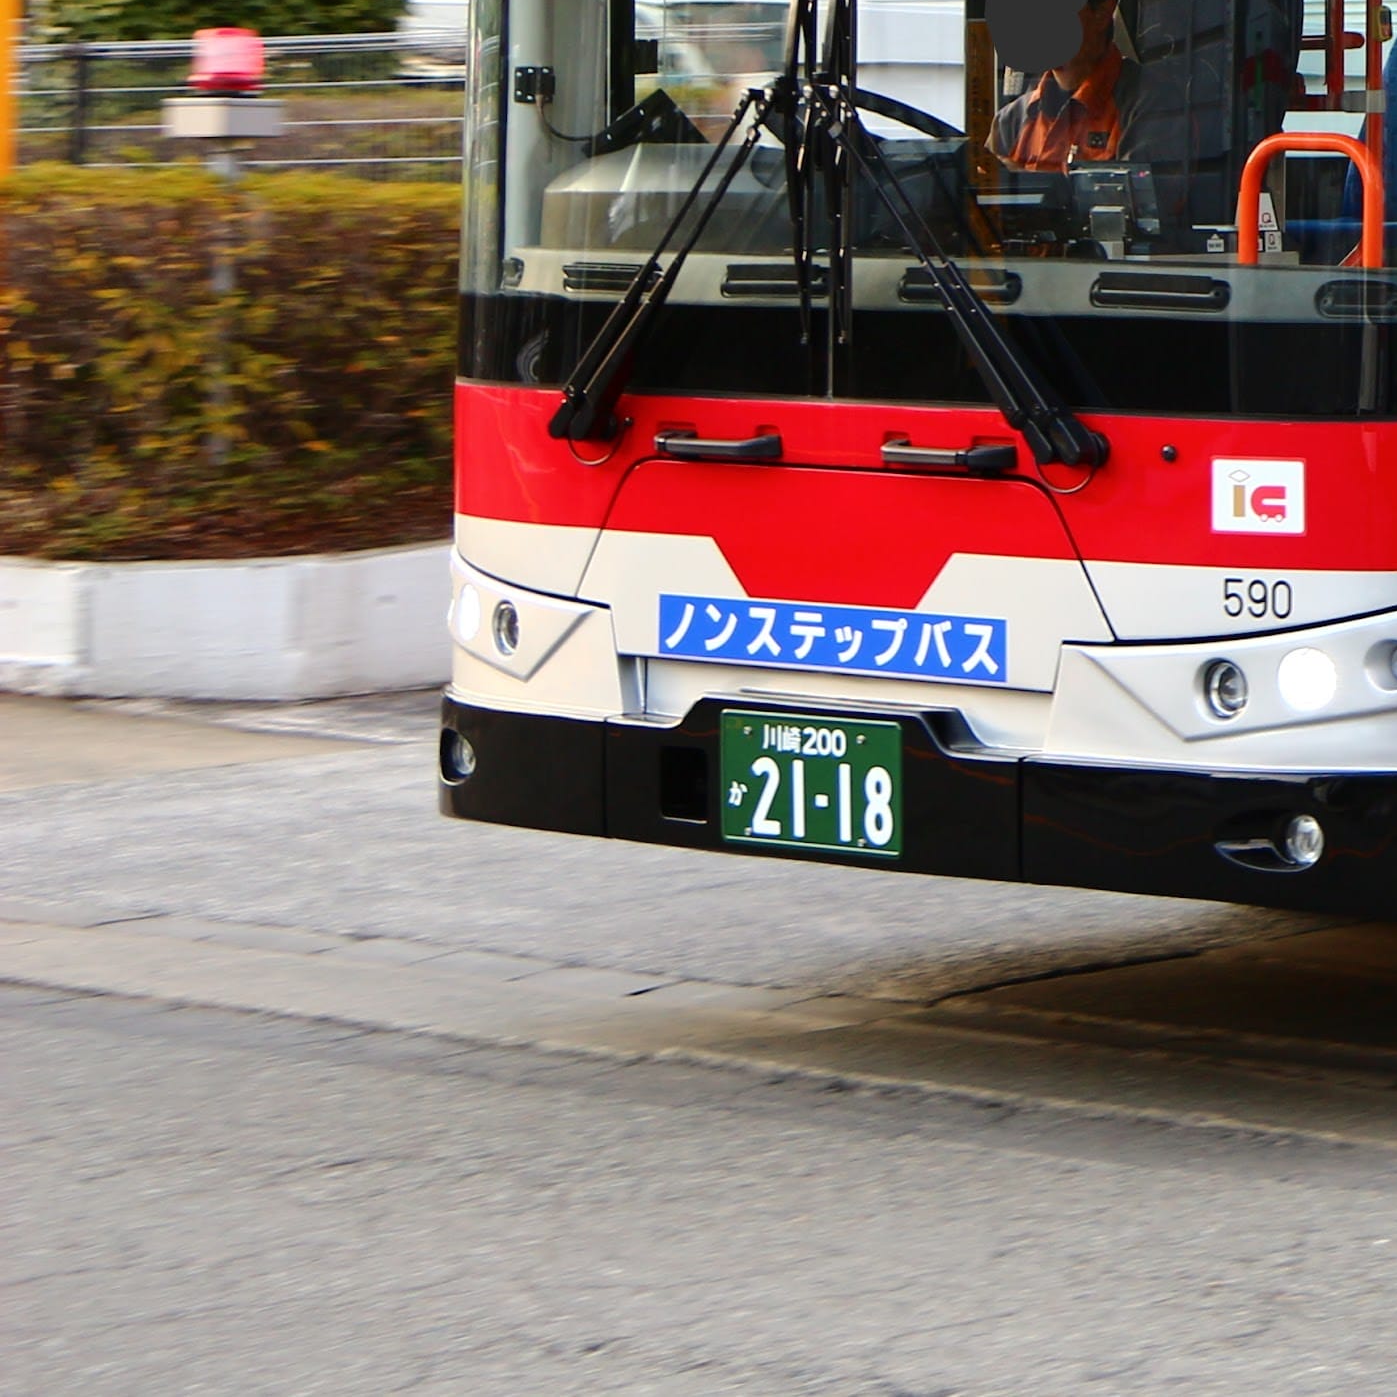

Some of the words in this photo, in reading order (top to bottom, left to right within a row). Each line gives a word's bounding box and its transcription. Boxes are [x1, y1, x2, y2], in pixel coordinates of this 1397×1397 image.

[1224, 578, 1292, 619] 590
[665, 603, 999, 675] ノンステップバス
[752, 756, 894, 846] 21-18
